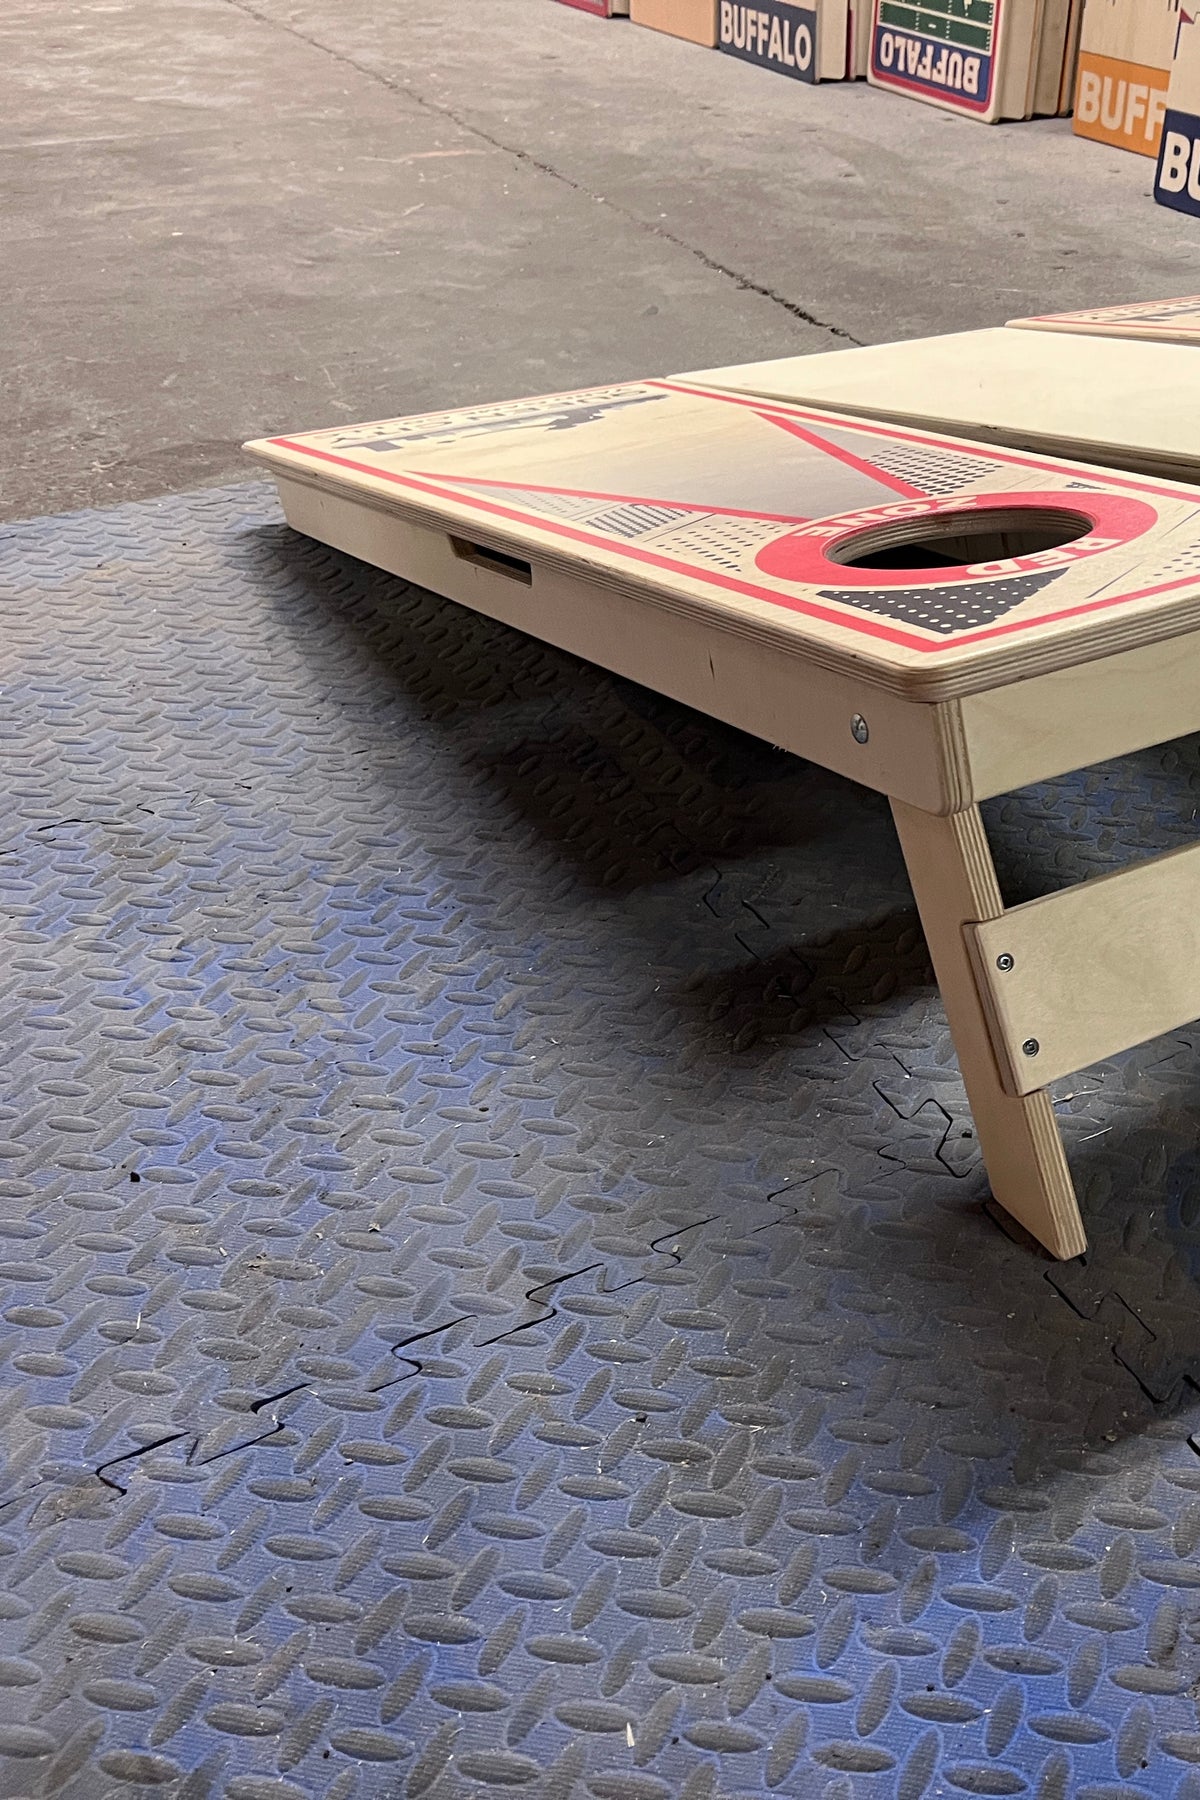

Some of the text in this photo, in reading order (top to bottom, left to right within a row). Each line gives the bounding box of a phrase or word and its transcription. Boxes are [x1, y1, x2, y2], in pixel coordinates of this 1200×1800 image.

[720, 1, 812, 71] BUFFALO
[879, 31, 982, 95] BUFFALO
[792, 495, 979, 538] ZONE
[966, 536, 1124, 577] RED
